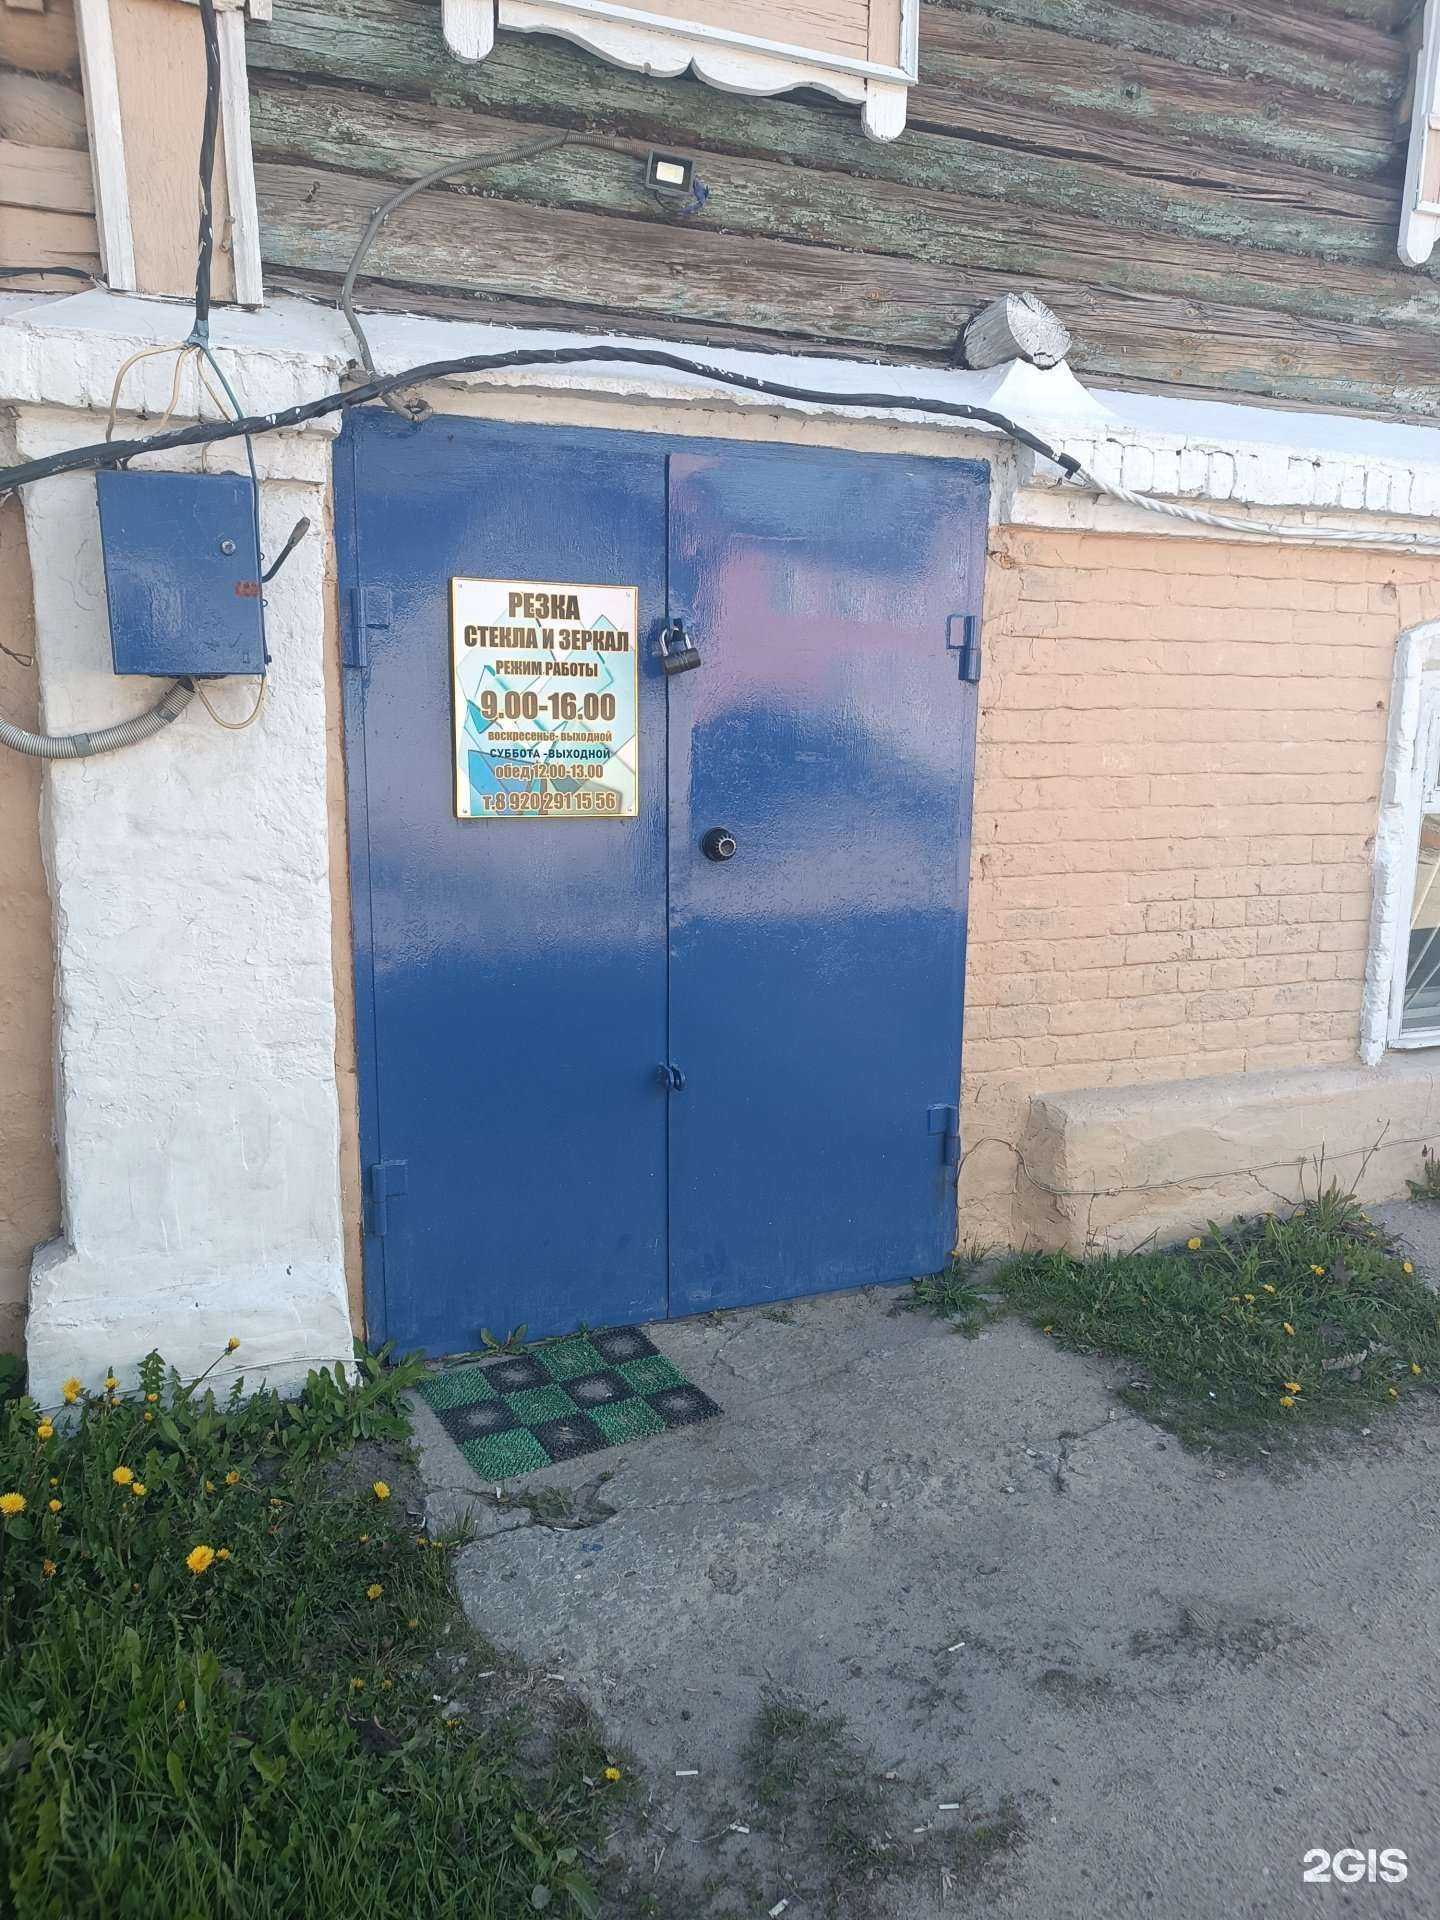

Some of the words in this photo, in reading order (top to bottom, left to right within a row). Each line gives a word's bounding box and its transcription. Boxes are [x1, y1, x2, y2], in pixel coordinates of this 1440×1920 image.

[508, 592, 580, 620] РЕЗКА
[464, 625, 538, 649] СТЕКЛА
[543, 628, 554, 649] И
[559, 628, 629, 652] ЗЕРКАЛ
[495, 660, 542, 675] РЕЖИМ
[546, 662, 598, 677] РАБОТЫ
[480, 691, 616, 721] 9.00-16.00
[561, 731, 612, 743] выходной
[490, 749, 540, 759] СУББОТА
[510, 792, 540, 810] 920
[544, 792, 570, 810] 291
[574, 793, 592, 809] 15
[596, 793, 616, 810] 56
